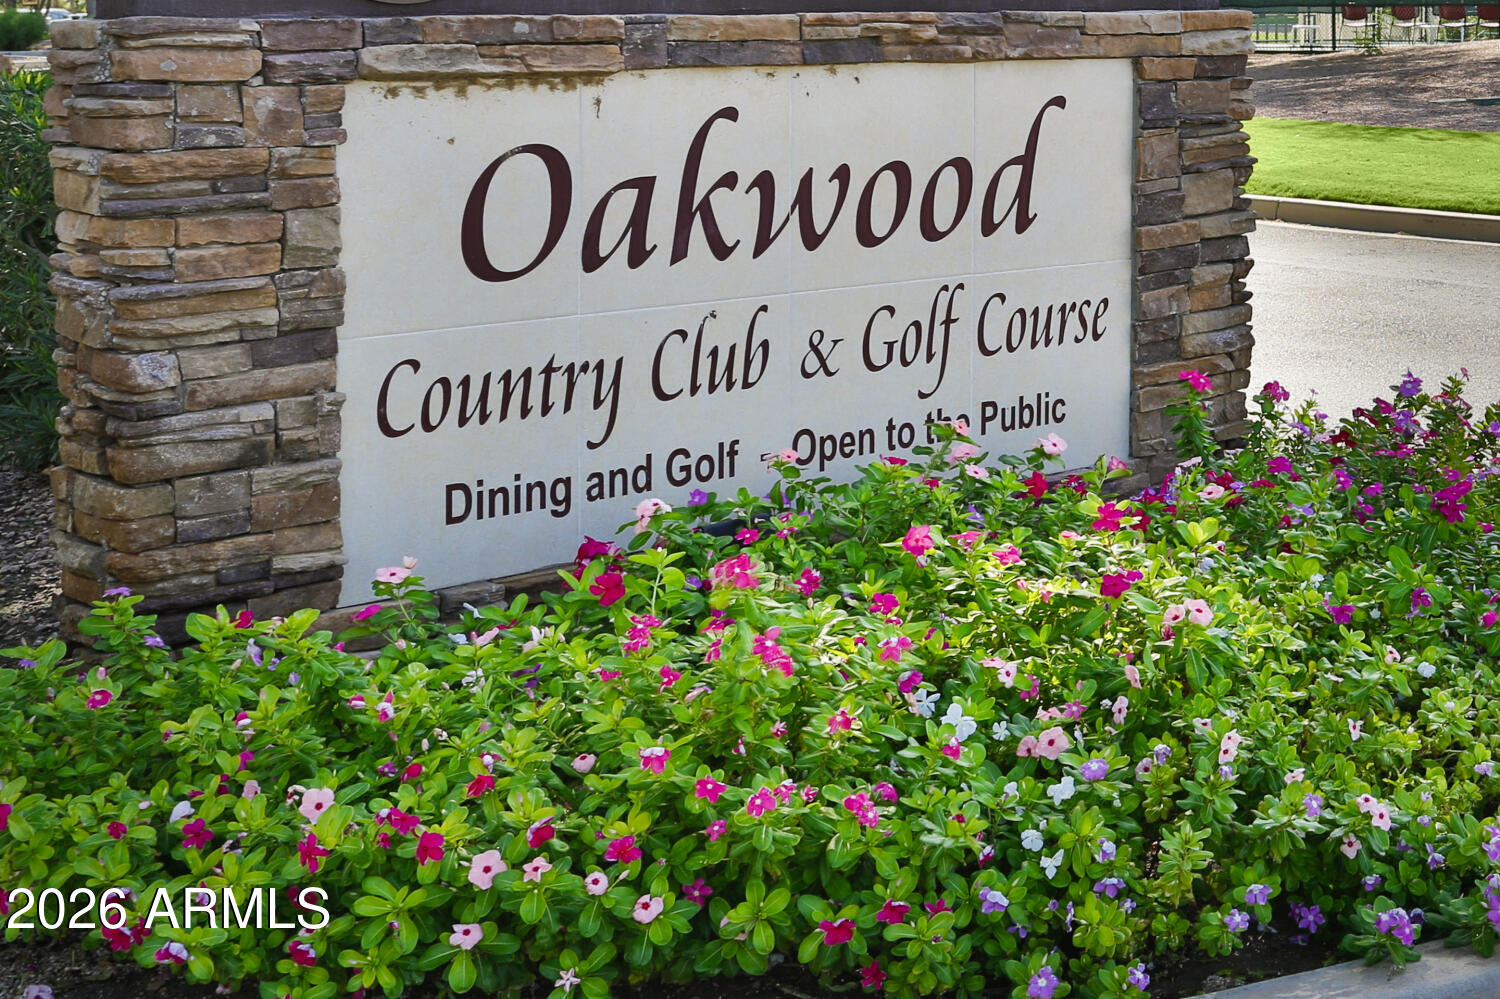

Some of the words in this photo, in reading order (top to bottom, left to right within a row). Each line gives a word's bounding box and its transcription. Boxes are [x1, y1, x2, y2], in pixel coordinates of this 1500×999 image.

[460, 95, 1067, 283] Oakwood
[376, 355, 625, 451] Country
[650, 304, 770, 402] Club
[800, 329, 844, 380] &
[862, 282, 966, 400] Golf
[977, 292, 1109, 357] Course
[445, 474, 573, 526] Dining
[585, 453, 653, 503] and
[665, 439, 740, 488] Golf
[791, 428, 876, 473] Open
[885, 417, 916, 452] to
[980, 391, 1067, 436] Public
